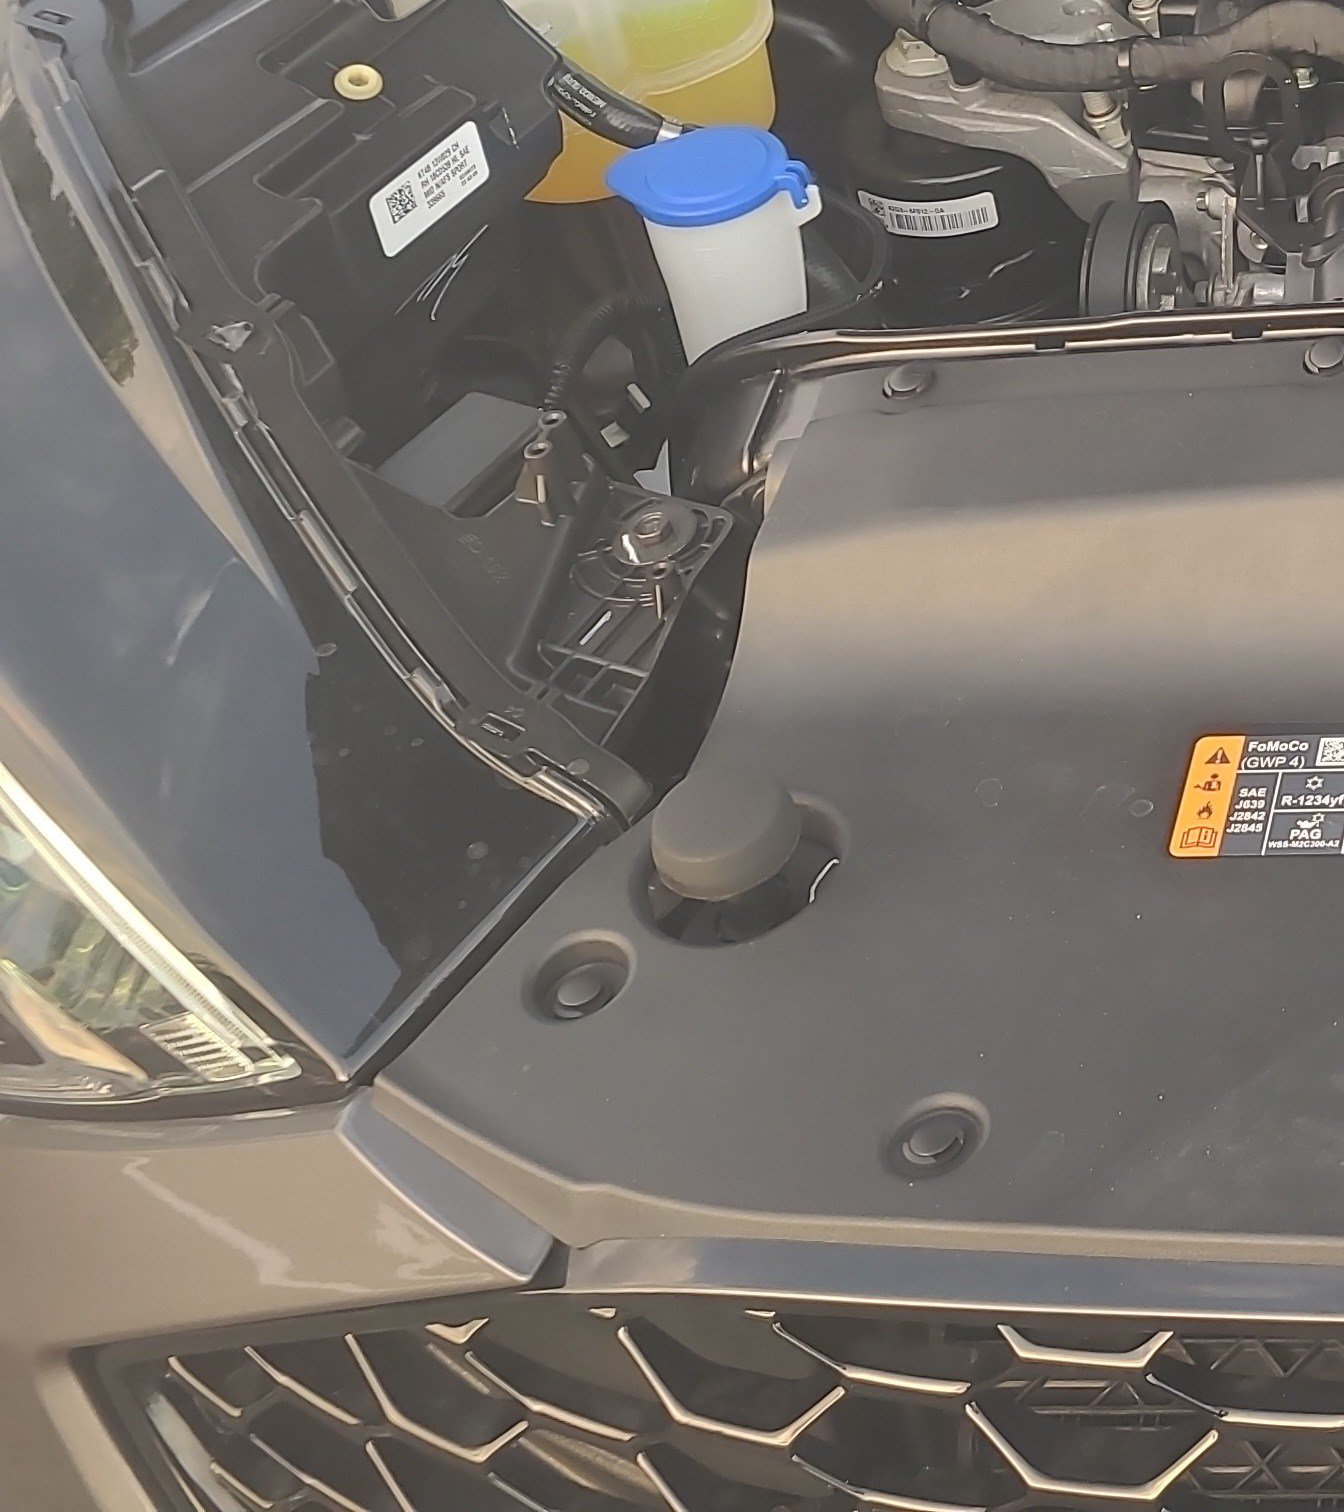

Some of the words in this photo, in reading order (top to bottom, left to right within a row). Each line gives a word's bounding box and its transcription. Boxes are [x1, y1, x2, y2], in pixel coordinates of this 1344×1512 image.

[1248, 740, 1309, 752] FoMoCo
[1241, 756, 1286, 770] (GWP
[1289, 756, 1305, 769] 4)
[1239, 788, 1267, 798] SAE
[1234, 800, 1265, 809] J639
[1229, 811, 1266, 821] J2842
[1226, 823, 1263, 833] J2845
[1289, 829, 1322, 840] PAG
